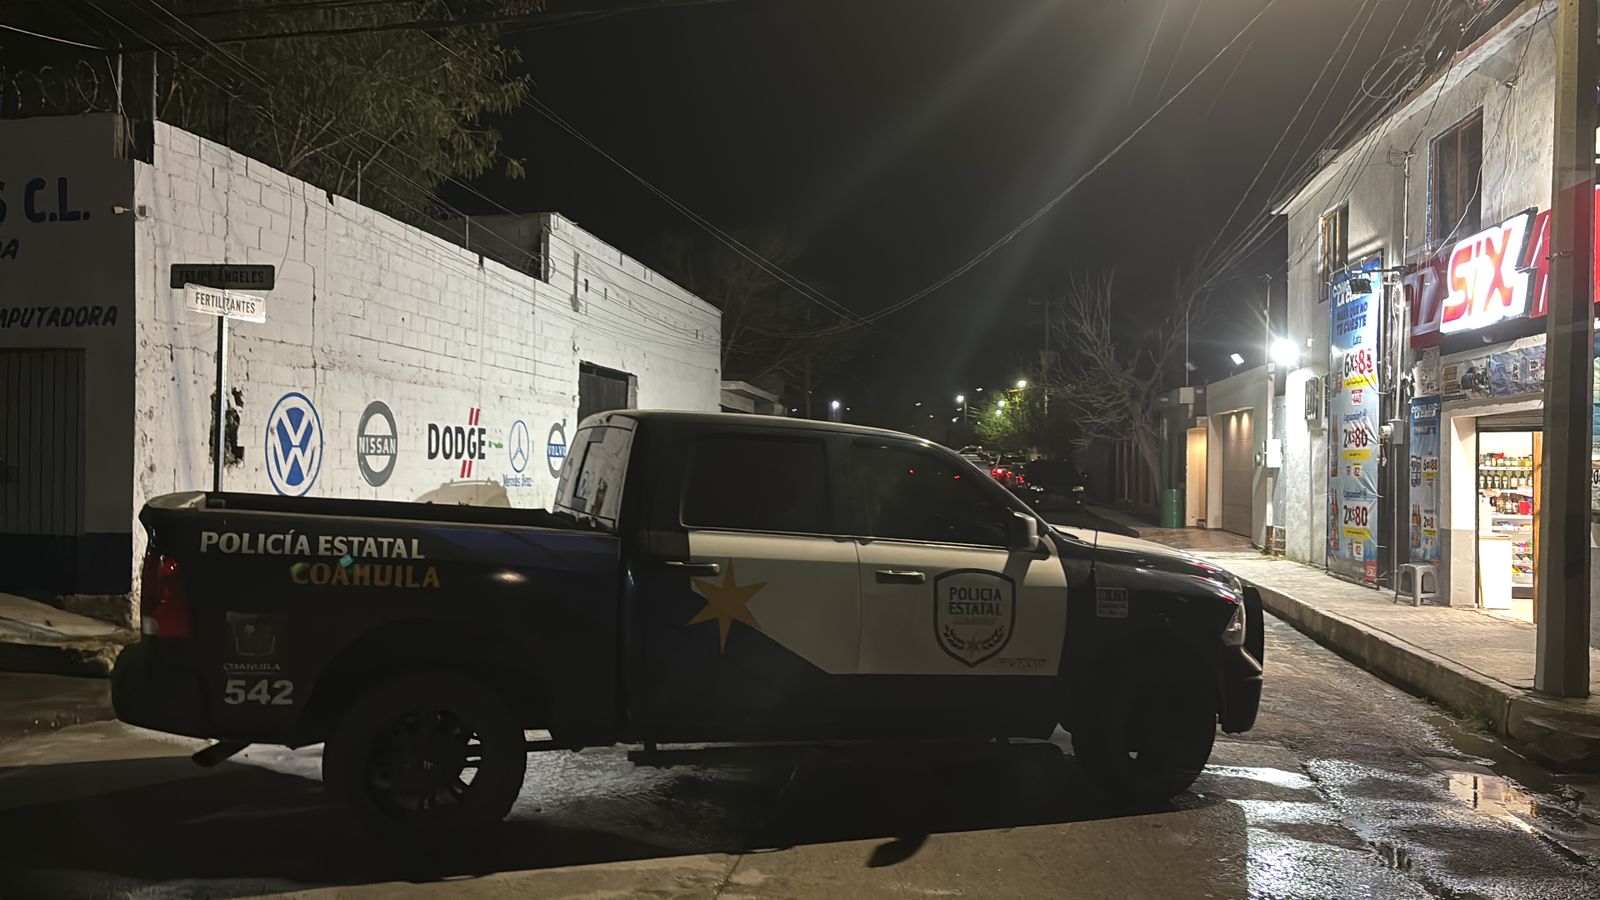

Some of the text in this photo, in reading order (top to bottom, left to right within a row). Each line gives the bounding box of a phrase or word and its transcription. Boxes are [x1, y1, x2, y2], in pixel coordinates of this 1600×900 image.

[24, 177, 91, 223] C.L.
[0, 238, 19, 260] A
[1442, 226, 1513, 325] SIX
[195, 291, 256, 314] FERTILIZANTES
[358, 436, 397, 456] NISSAN
[427, 423, 487, 460] DODGE
[200, 529, 425, 559] POLICÍA ESTATAL
[290, 562, 441, 588] COAHUILA
[949, 587, 1002, 601] POLICIA
[949, 602, 1003, 616] ESTATAL
[223, 662, 281, 672] COAHUILA
[224, 679, 294, 705] 542
